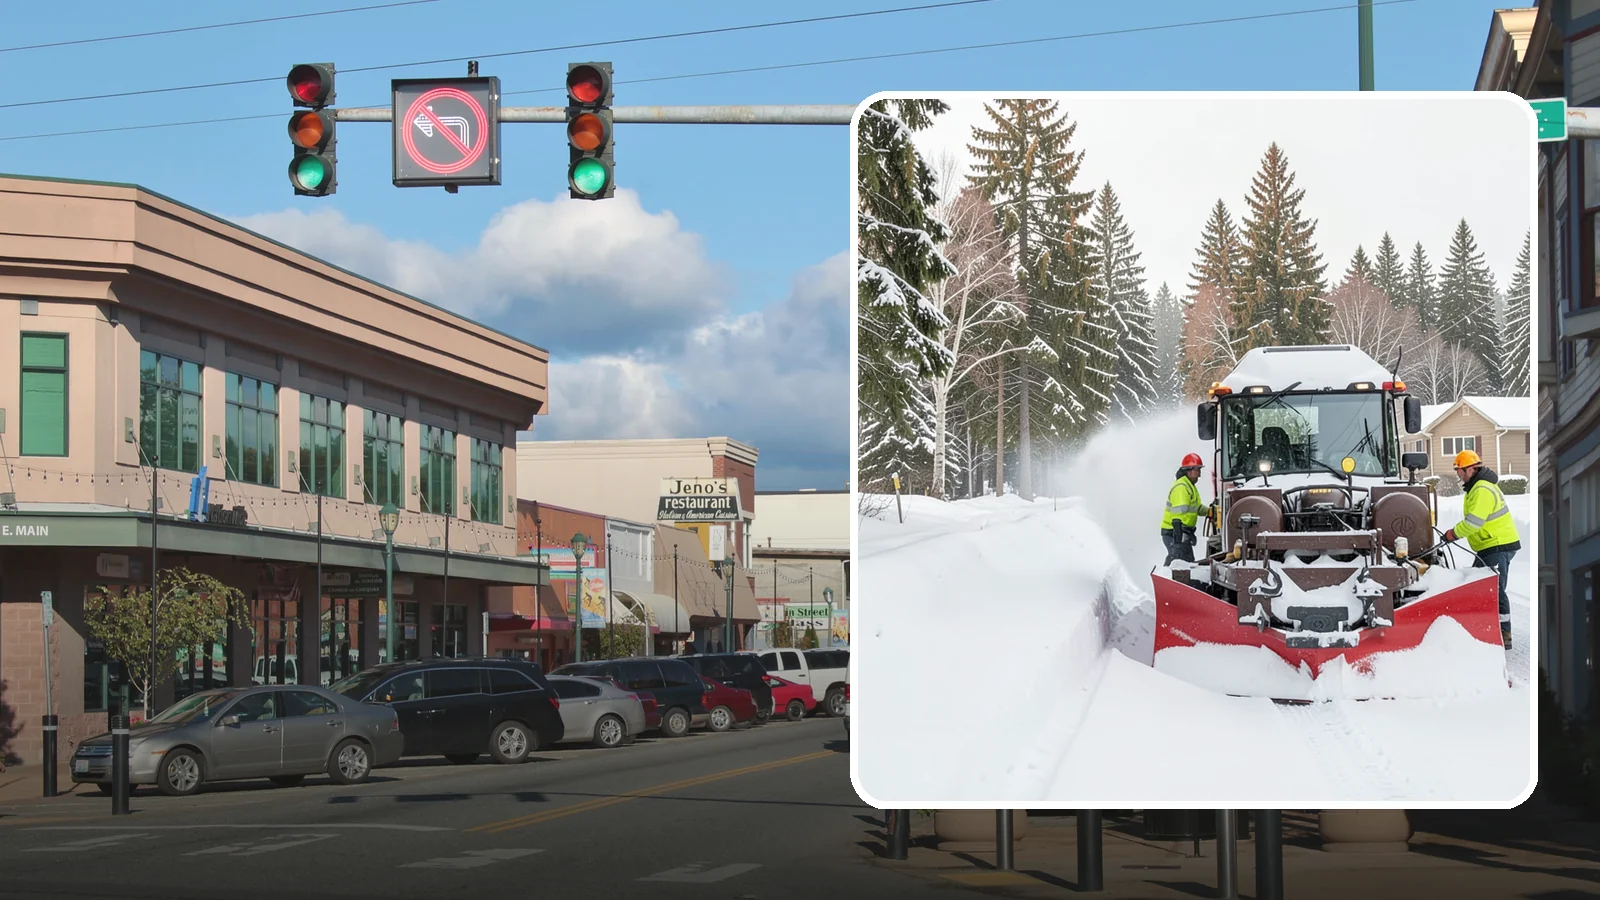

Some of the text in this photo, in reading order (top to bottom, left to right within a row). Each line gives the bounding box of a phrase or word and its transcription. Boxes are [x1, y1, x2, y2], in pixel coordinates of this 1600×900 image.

[670, 480, 727, 494] Jeno's
[665, 497, 731, 509] restaurant
[658, 509, 681, 520] Italian
[685, 509, 715, 519] American
[715, 509, 737, 519] Cuisine
[2, 525, 49, 536] E. MAIN
[797, 608, 828, 616] Street
